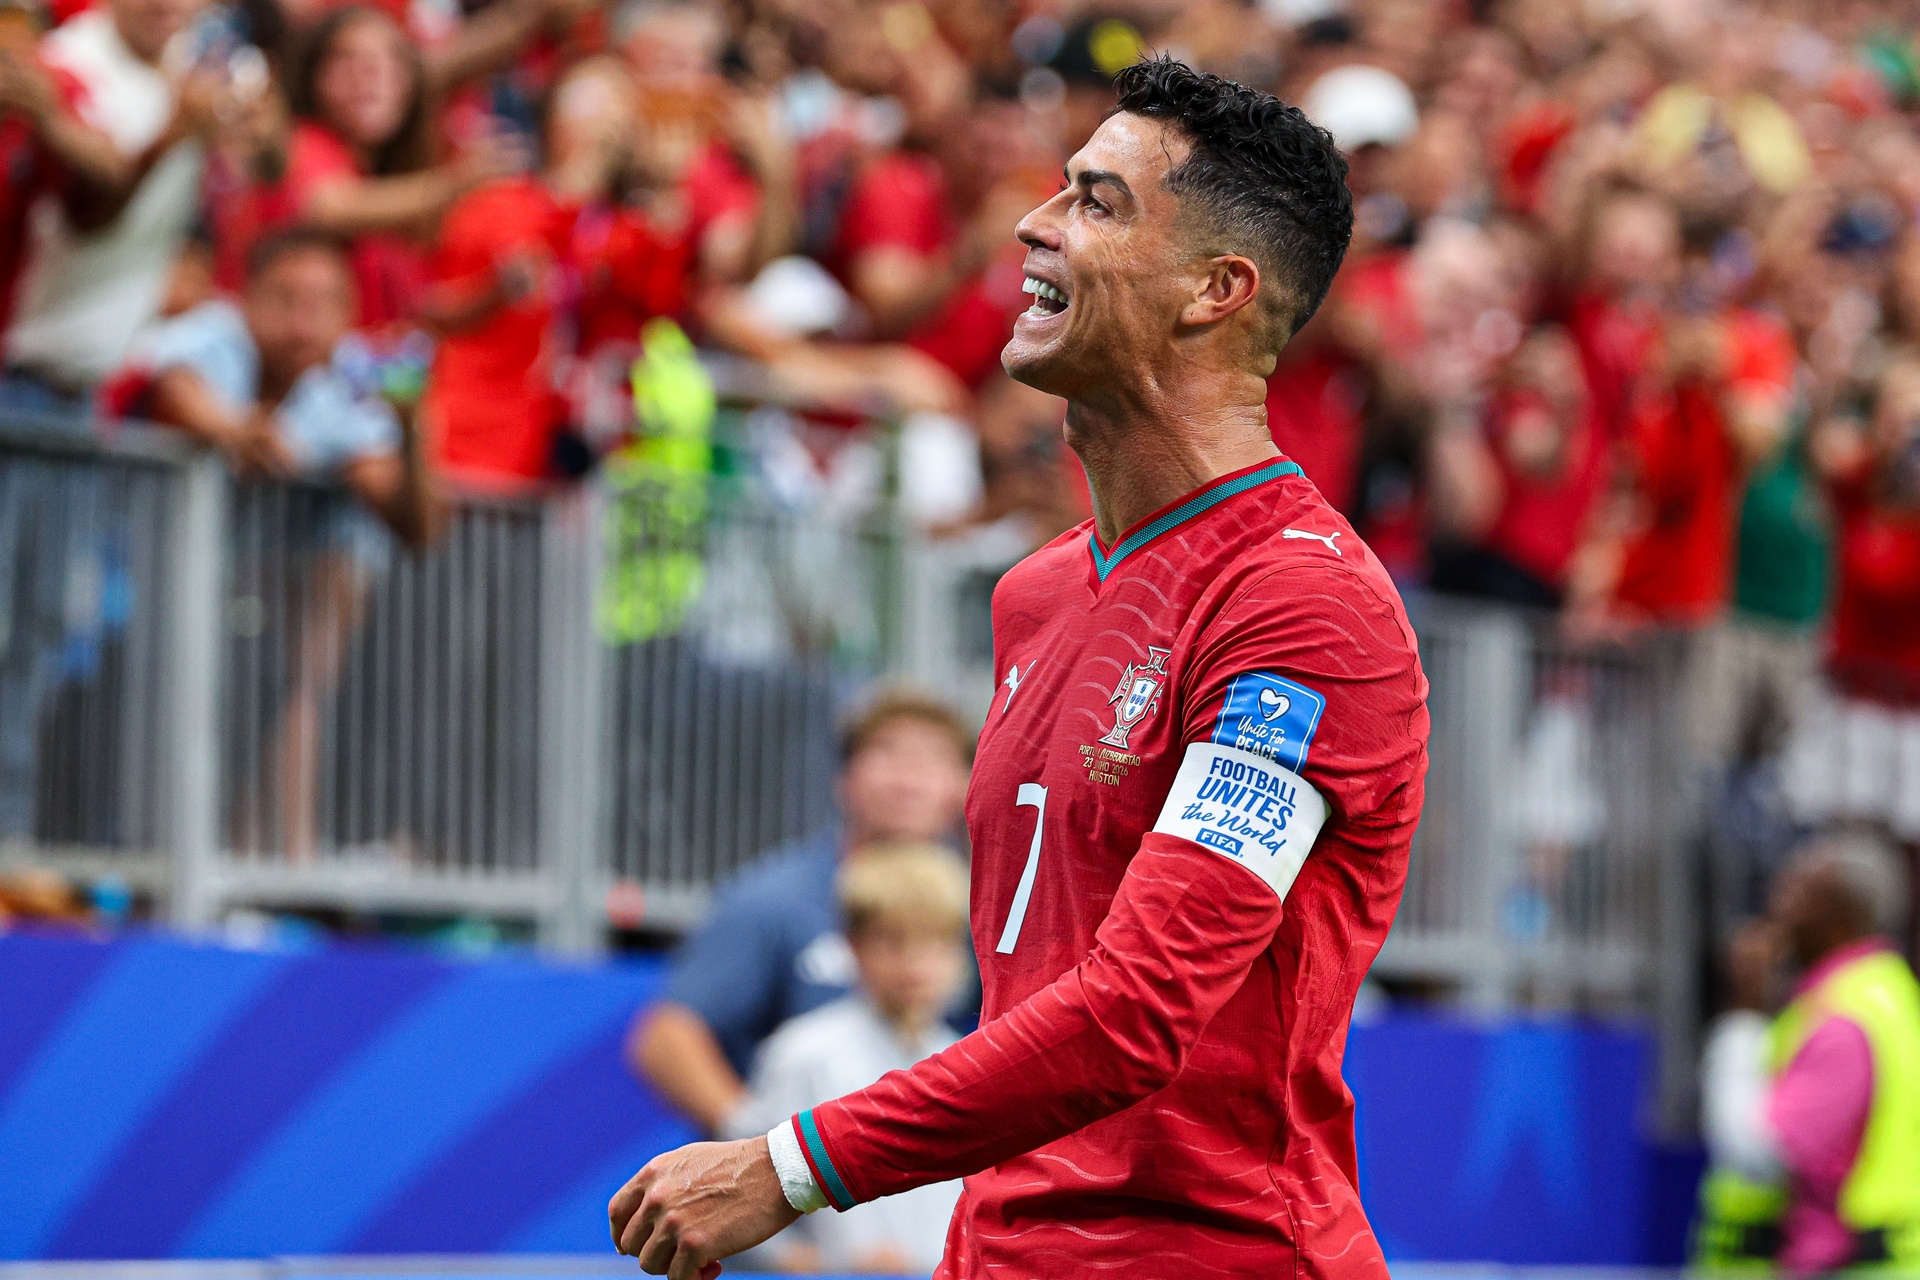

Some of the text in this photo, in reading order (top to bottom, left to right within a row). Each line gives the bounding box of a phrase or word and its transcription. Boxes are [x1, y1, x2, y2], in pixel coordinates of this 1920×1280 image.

[1235, 735, 1280, 762] PEACE
[1237, 715, 1286, 745] Unite For
[1083, 757, 1094, 768] 23
[1112, 764, 1129, 777] 2026
[1209, 756, 1297, 808] FOOTBALL
[1196, 776, 1293, 831] UNITES
[1181, 802, 1287, 857] the World
[1200, 830, 1237, 852] FIFA
[995, 782, 1049, 955] 7
